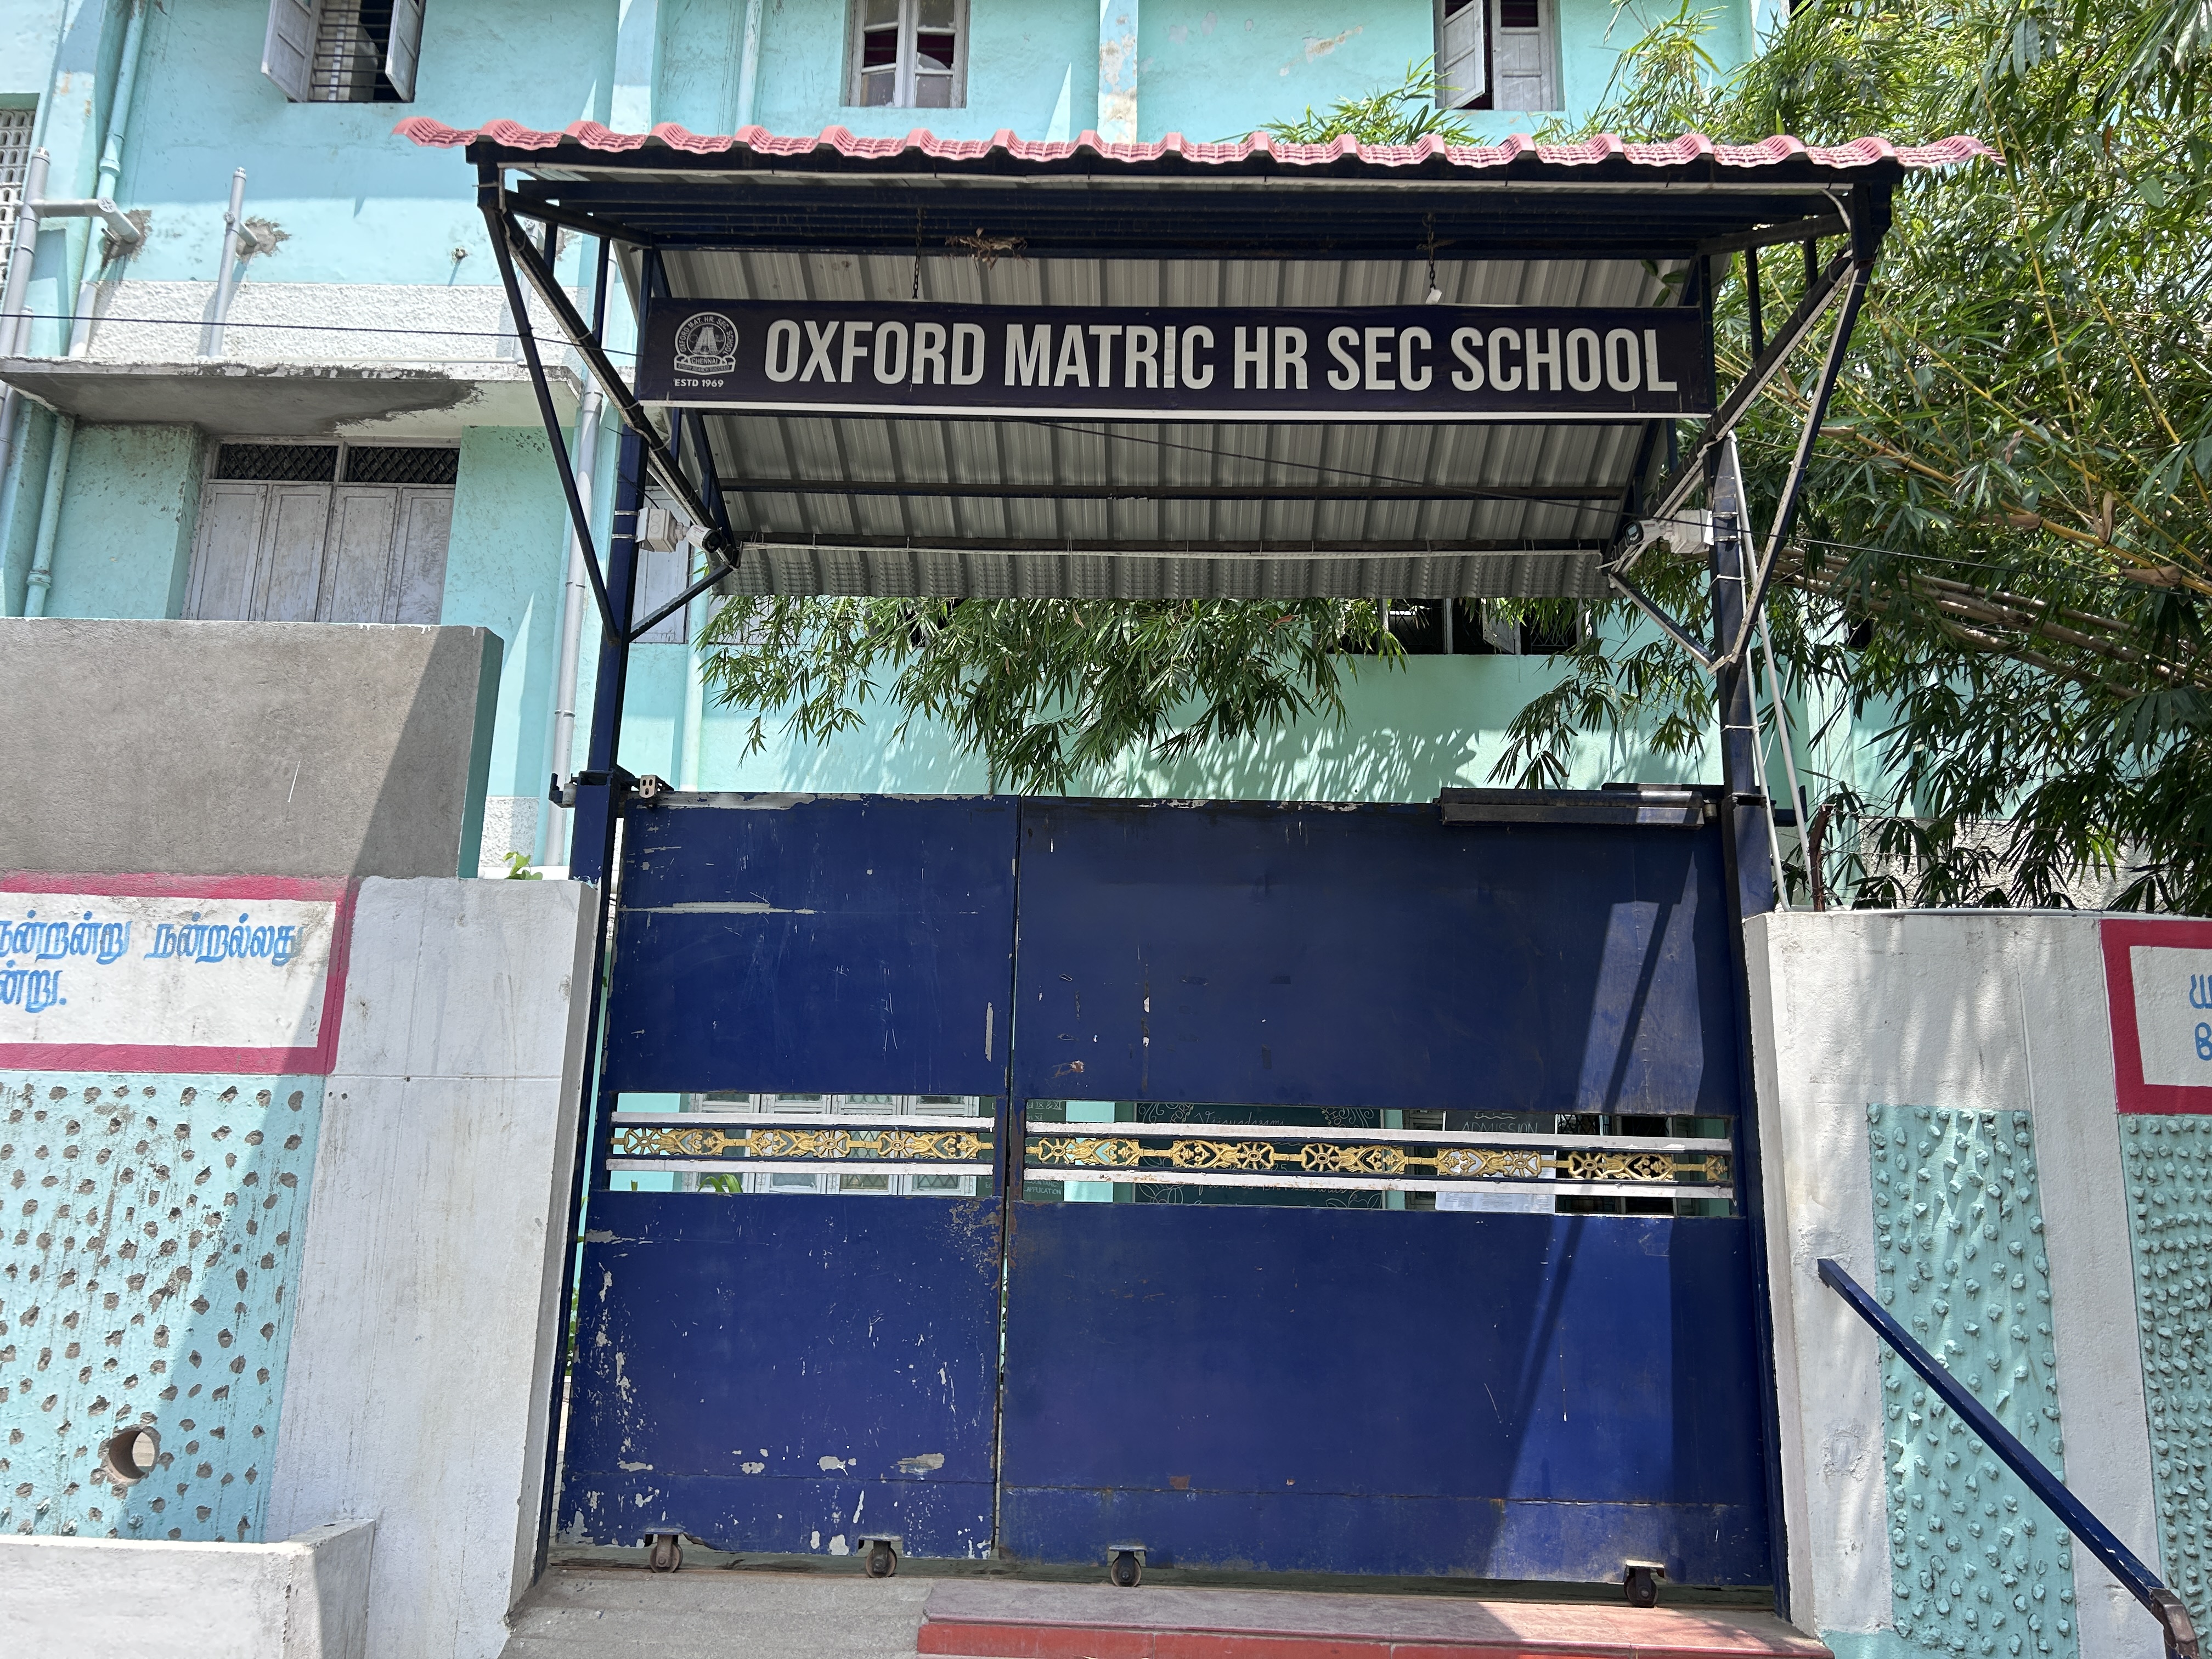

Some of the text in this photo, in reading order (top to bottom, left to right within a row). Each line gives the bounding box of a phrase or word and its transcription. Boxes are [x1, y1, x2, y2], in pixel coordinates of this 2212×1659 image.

[679, 327, 690, 352] OXFORD
[722, 330, 734, 355] SCHOOL
[765, 319, 1678, 392] OXFORD MATRIC HR SEC SCHOOL
[674, 378, 724, 388] ESTD 1969
[0, 960, 67, 1013] ன்று.
[1462, 1121, 1538, 1133] ADMISSION
